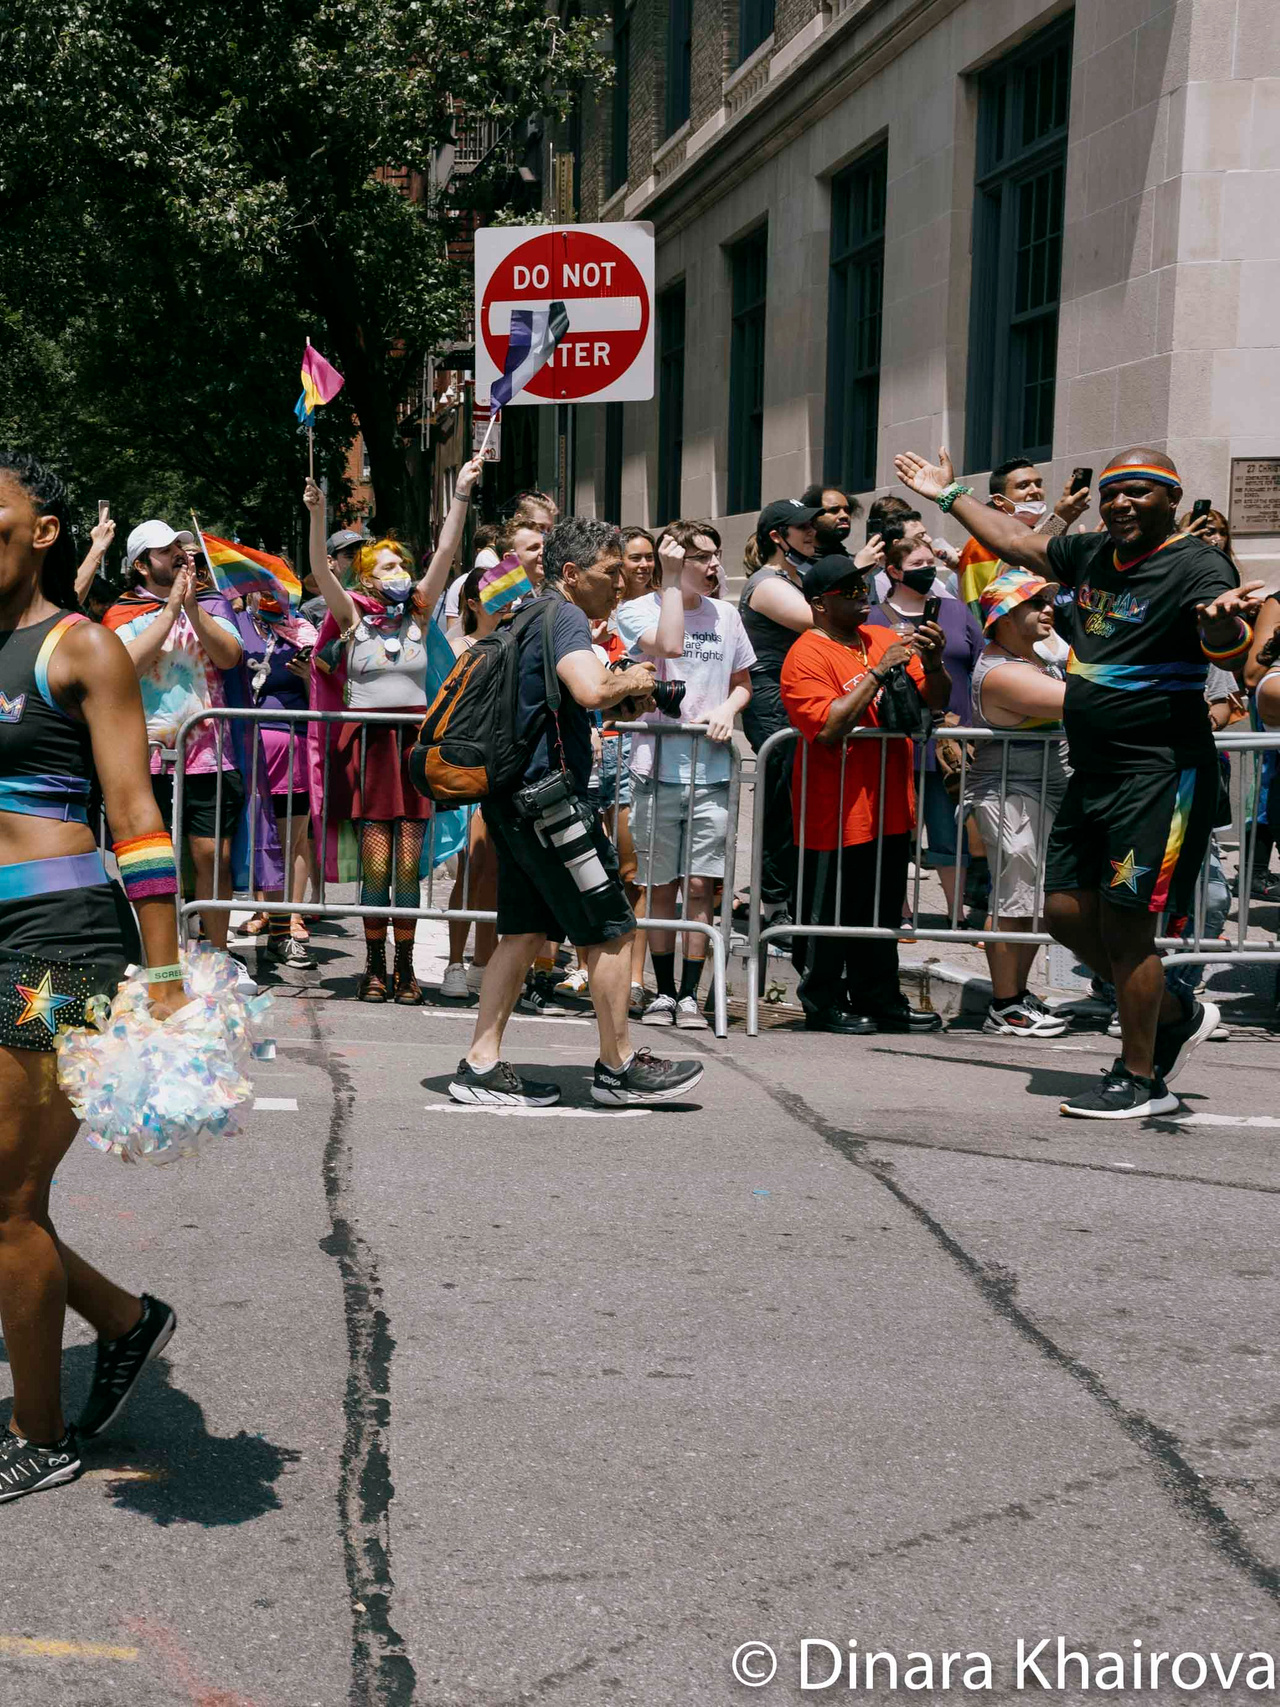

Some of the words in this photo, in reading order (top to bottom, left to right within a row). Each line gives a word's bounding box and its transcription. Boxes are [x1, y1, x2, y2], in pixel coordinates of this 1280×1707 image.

[513, 264, 550, 290] DO
[562, 262, 616, 288] NOT
[546, 341, 611, 368] TER
[692, 631, 722, 643] rights
[685, 641, 701, 650] are
[695, 650, 724, 662] rights
